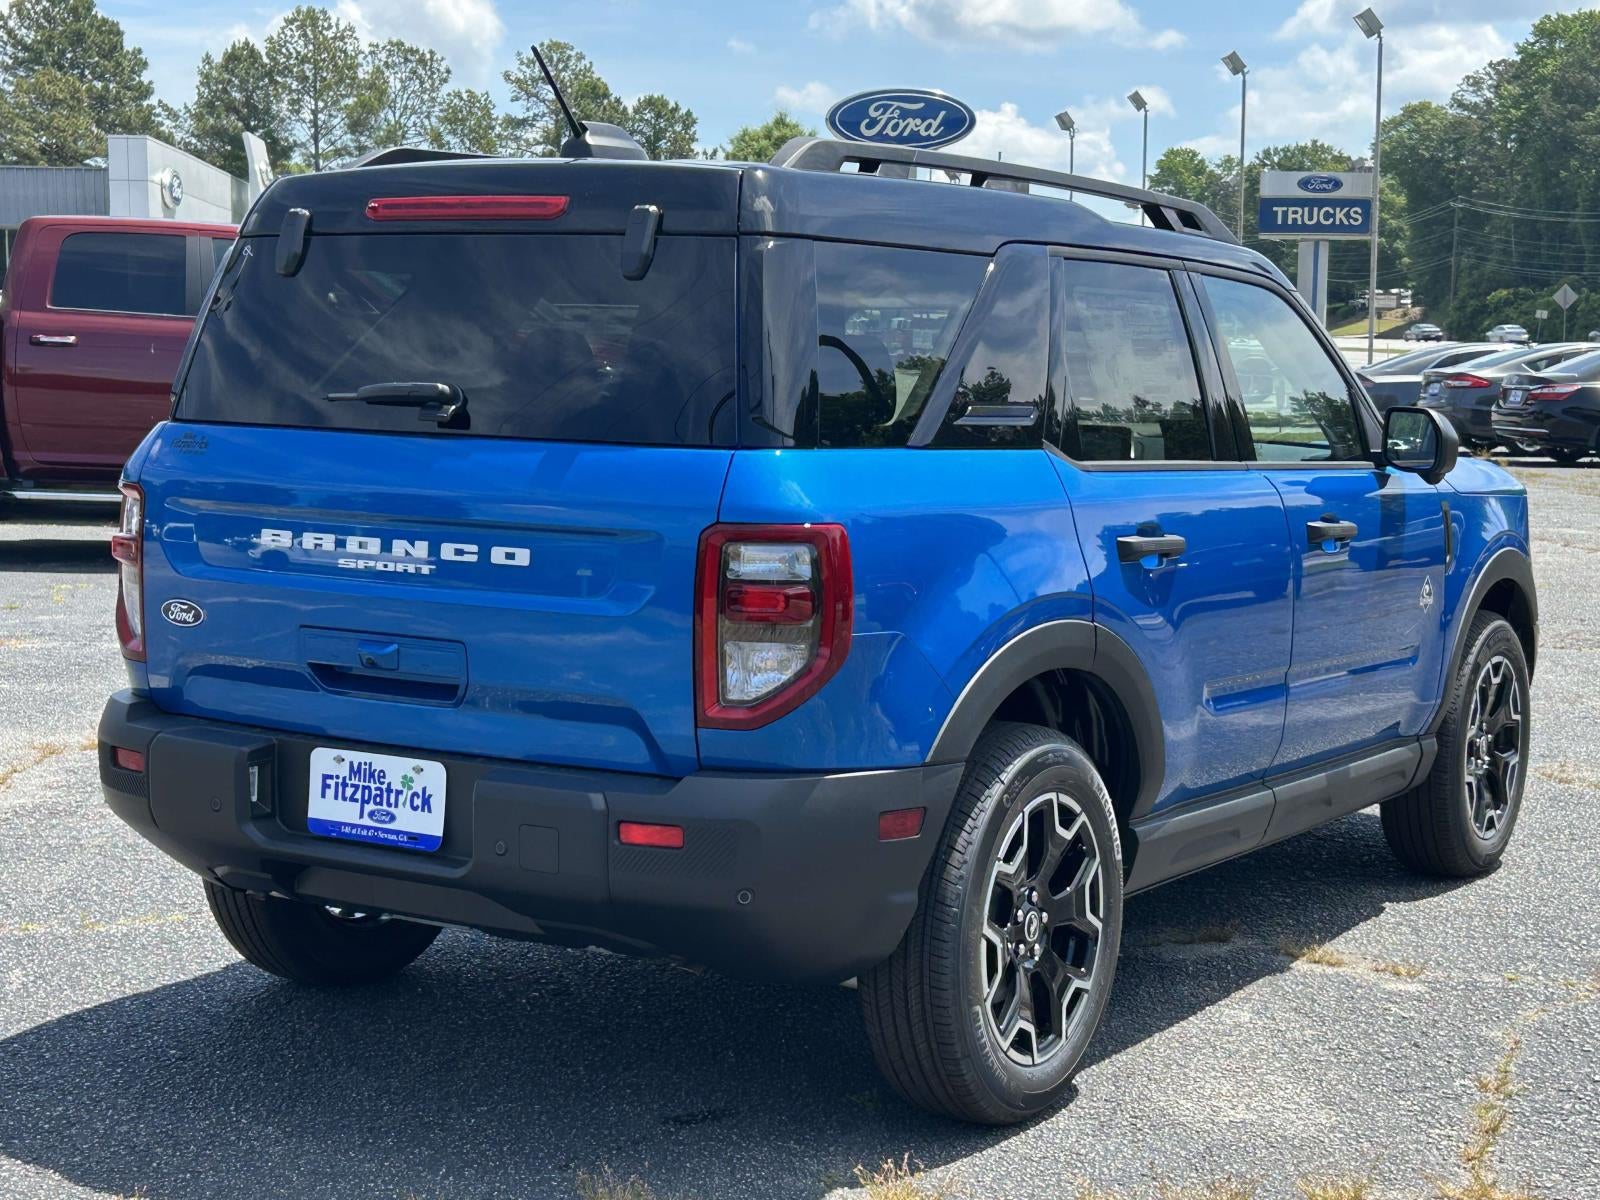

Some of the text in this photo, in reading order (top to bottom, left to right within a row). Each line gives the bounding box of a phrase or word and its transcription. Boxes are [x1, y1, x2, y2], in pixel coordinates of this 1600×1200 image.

[859, 100, 947, 137] Ford
[1307, 177, 1335, 190] Ford
[1272, 206, 1363, 226] TRUCKS
[260, 528, 531, 567] BRONCO
[337, 557, 437, 576] SPORT
[167, 601, 195, 623] Ford
[348, 760, 387, 786] Mike
[320, 773, 433, 820] Fitzpatrick
